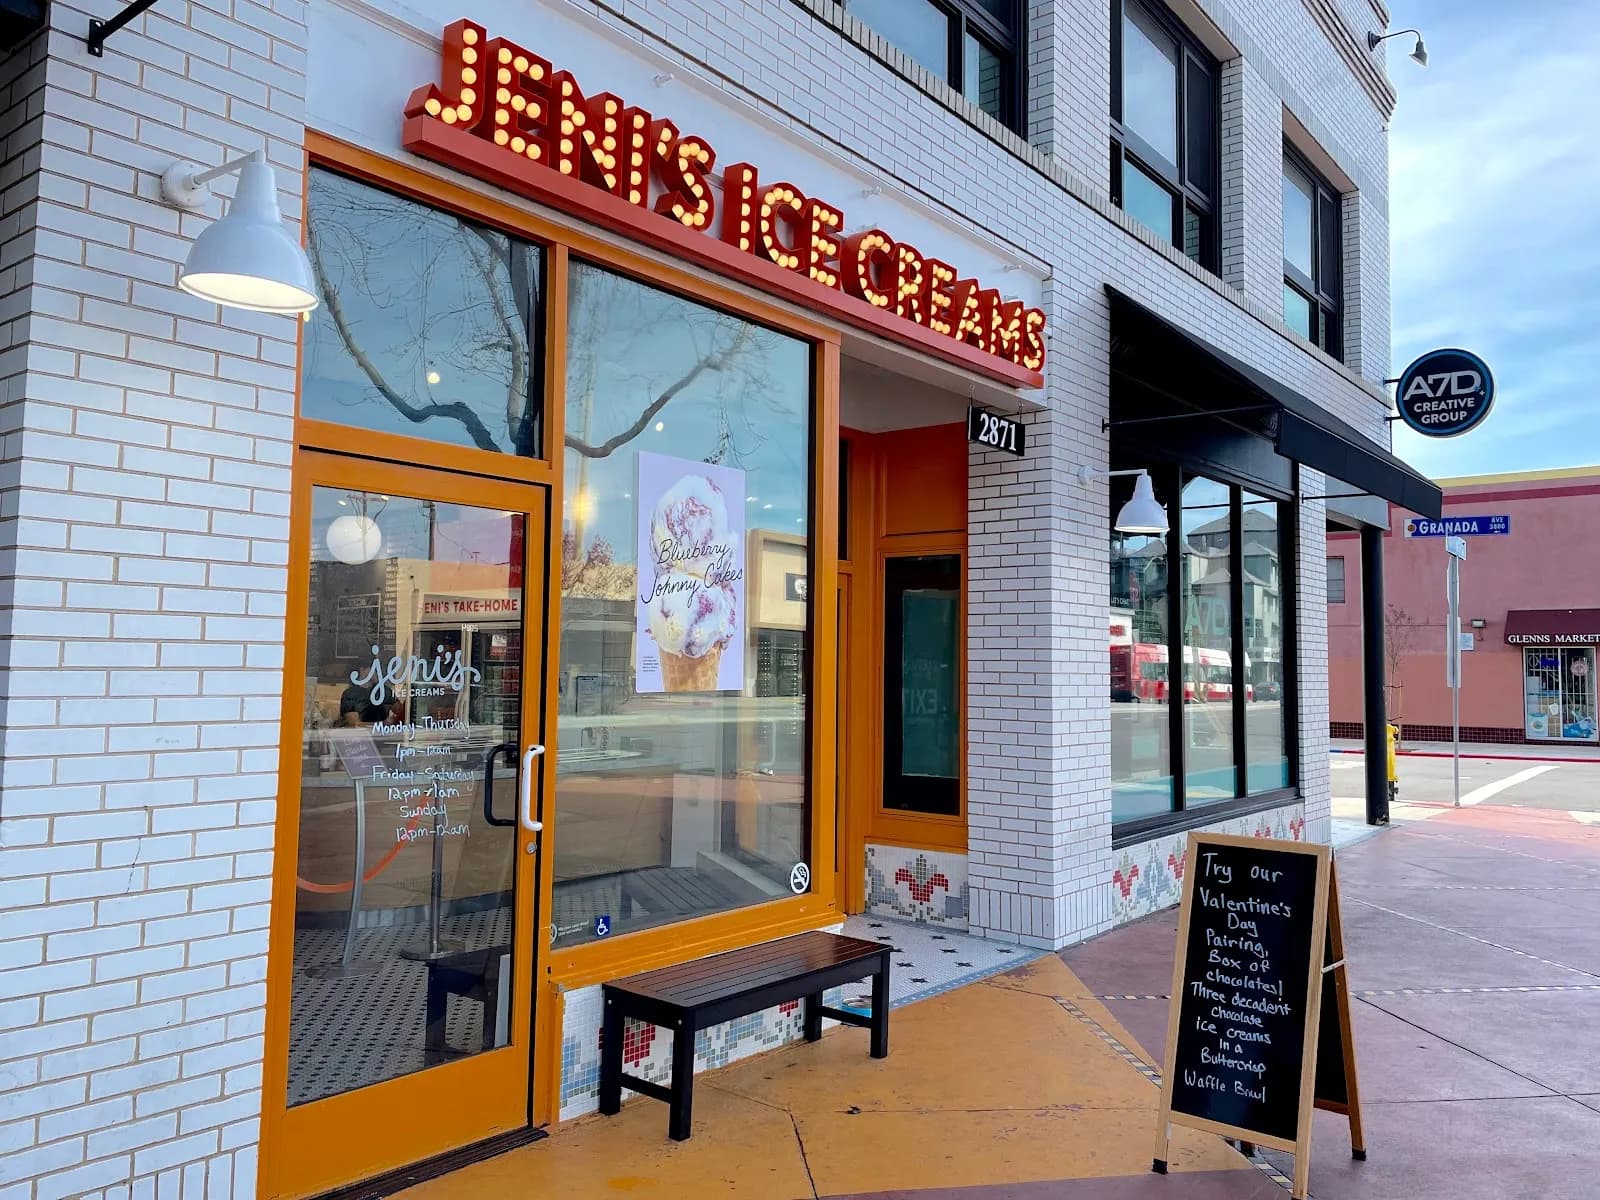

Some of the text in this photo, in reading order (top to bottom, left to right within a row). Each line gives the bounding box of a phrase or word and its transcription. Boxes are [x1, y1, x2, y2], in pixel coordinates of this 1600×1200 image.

[404, 19, 1046, 372] JENI'S ICE CREAMS
[1403, 370, 1482, 401] A7D
[1414, 398, 1475, 412] CREATIVE
[1421, 411, 1468, 424] GROUP
[978, 412, 1017, 451] 2871
[1419, 520, 1479, 534] GRANADA
[657, 538, 730, 569] Blueberry
[640, 564, 744, 608] Johnny Cakes
[419, 598, 518, 614] ENI'S TAKE-HOME
[1508, 634, 1600, 644] GLENNS MARKET
[350, 644, 481, 706] jeni's
[392, 686, 445, 698] ICE CREAMS
[400, 802, 448, 827] Sunday
[1202, 852, 1284, 884] Try our
[1200, 886, 1292, 918] Valentine's
[1228, 912, 1259, 938] Day
[1208, 949, 1271, 972] Box of
[1190, 981, 1292, 1016] Three decadent
[1196, 1016, 1272, 1044] ice creams
[1234, 1044, 1244, 1054] a
[1200, 1046, 1266, 1080] Buttercrisp
[1184, 1069, 1226, 1092] Waffle
